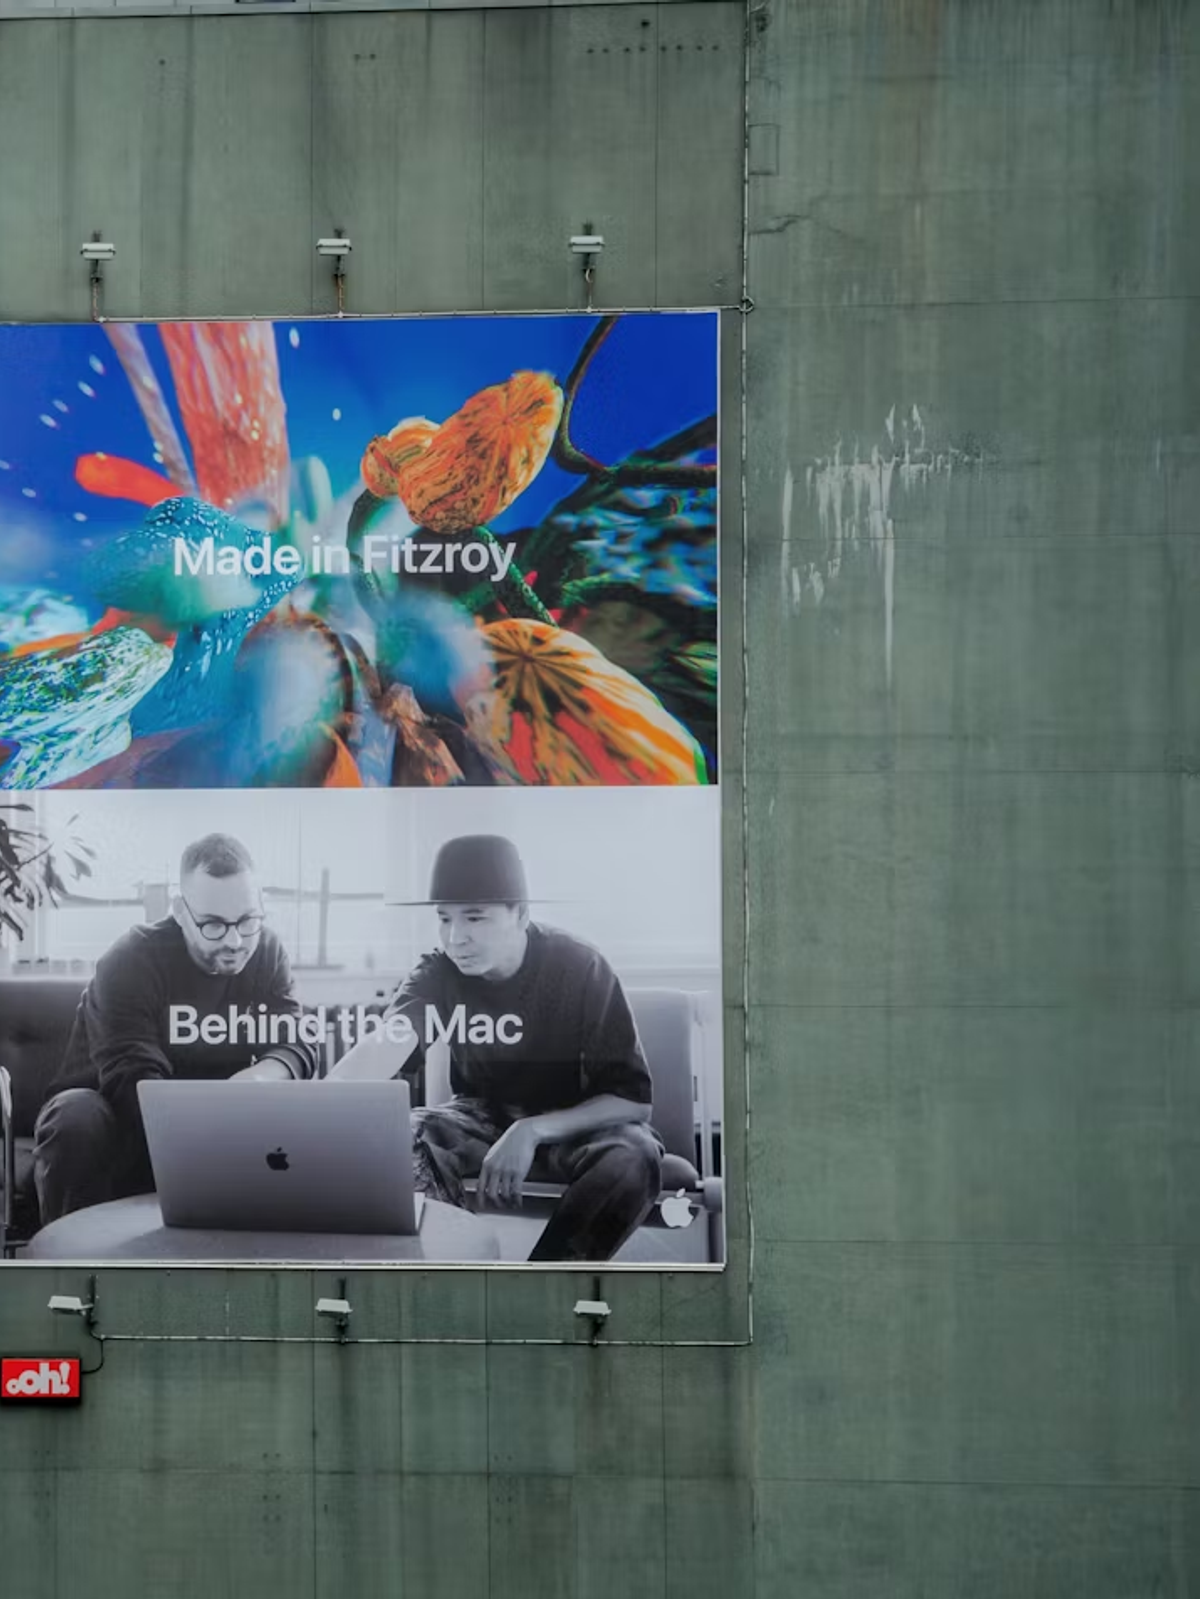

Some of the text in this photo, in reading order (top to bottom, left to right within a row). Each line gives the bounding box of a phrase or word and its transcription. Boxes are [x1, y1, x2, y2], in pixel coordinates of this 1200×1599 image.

[174, 534, 516, 581] Made in Fitzroy
[169, 1004, 523, 1044] Behind the Mac
